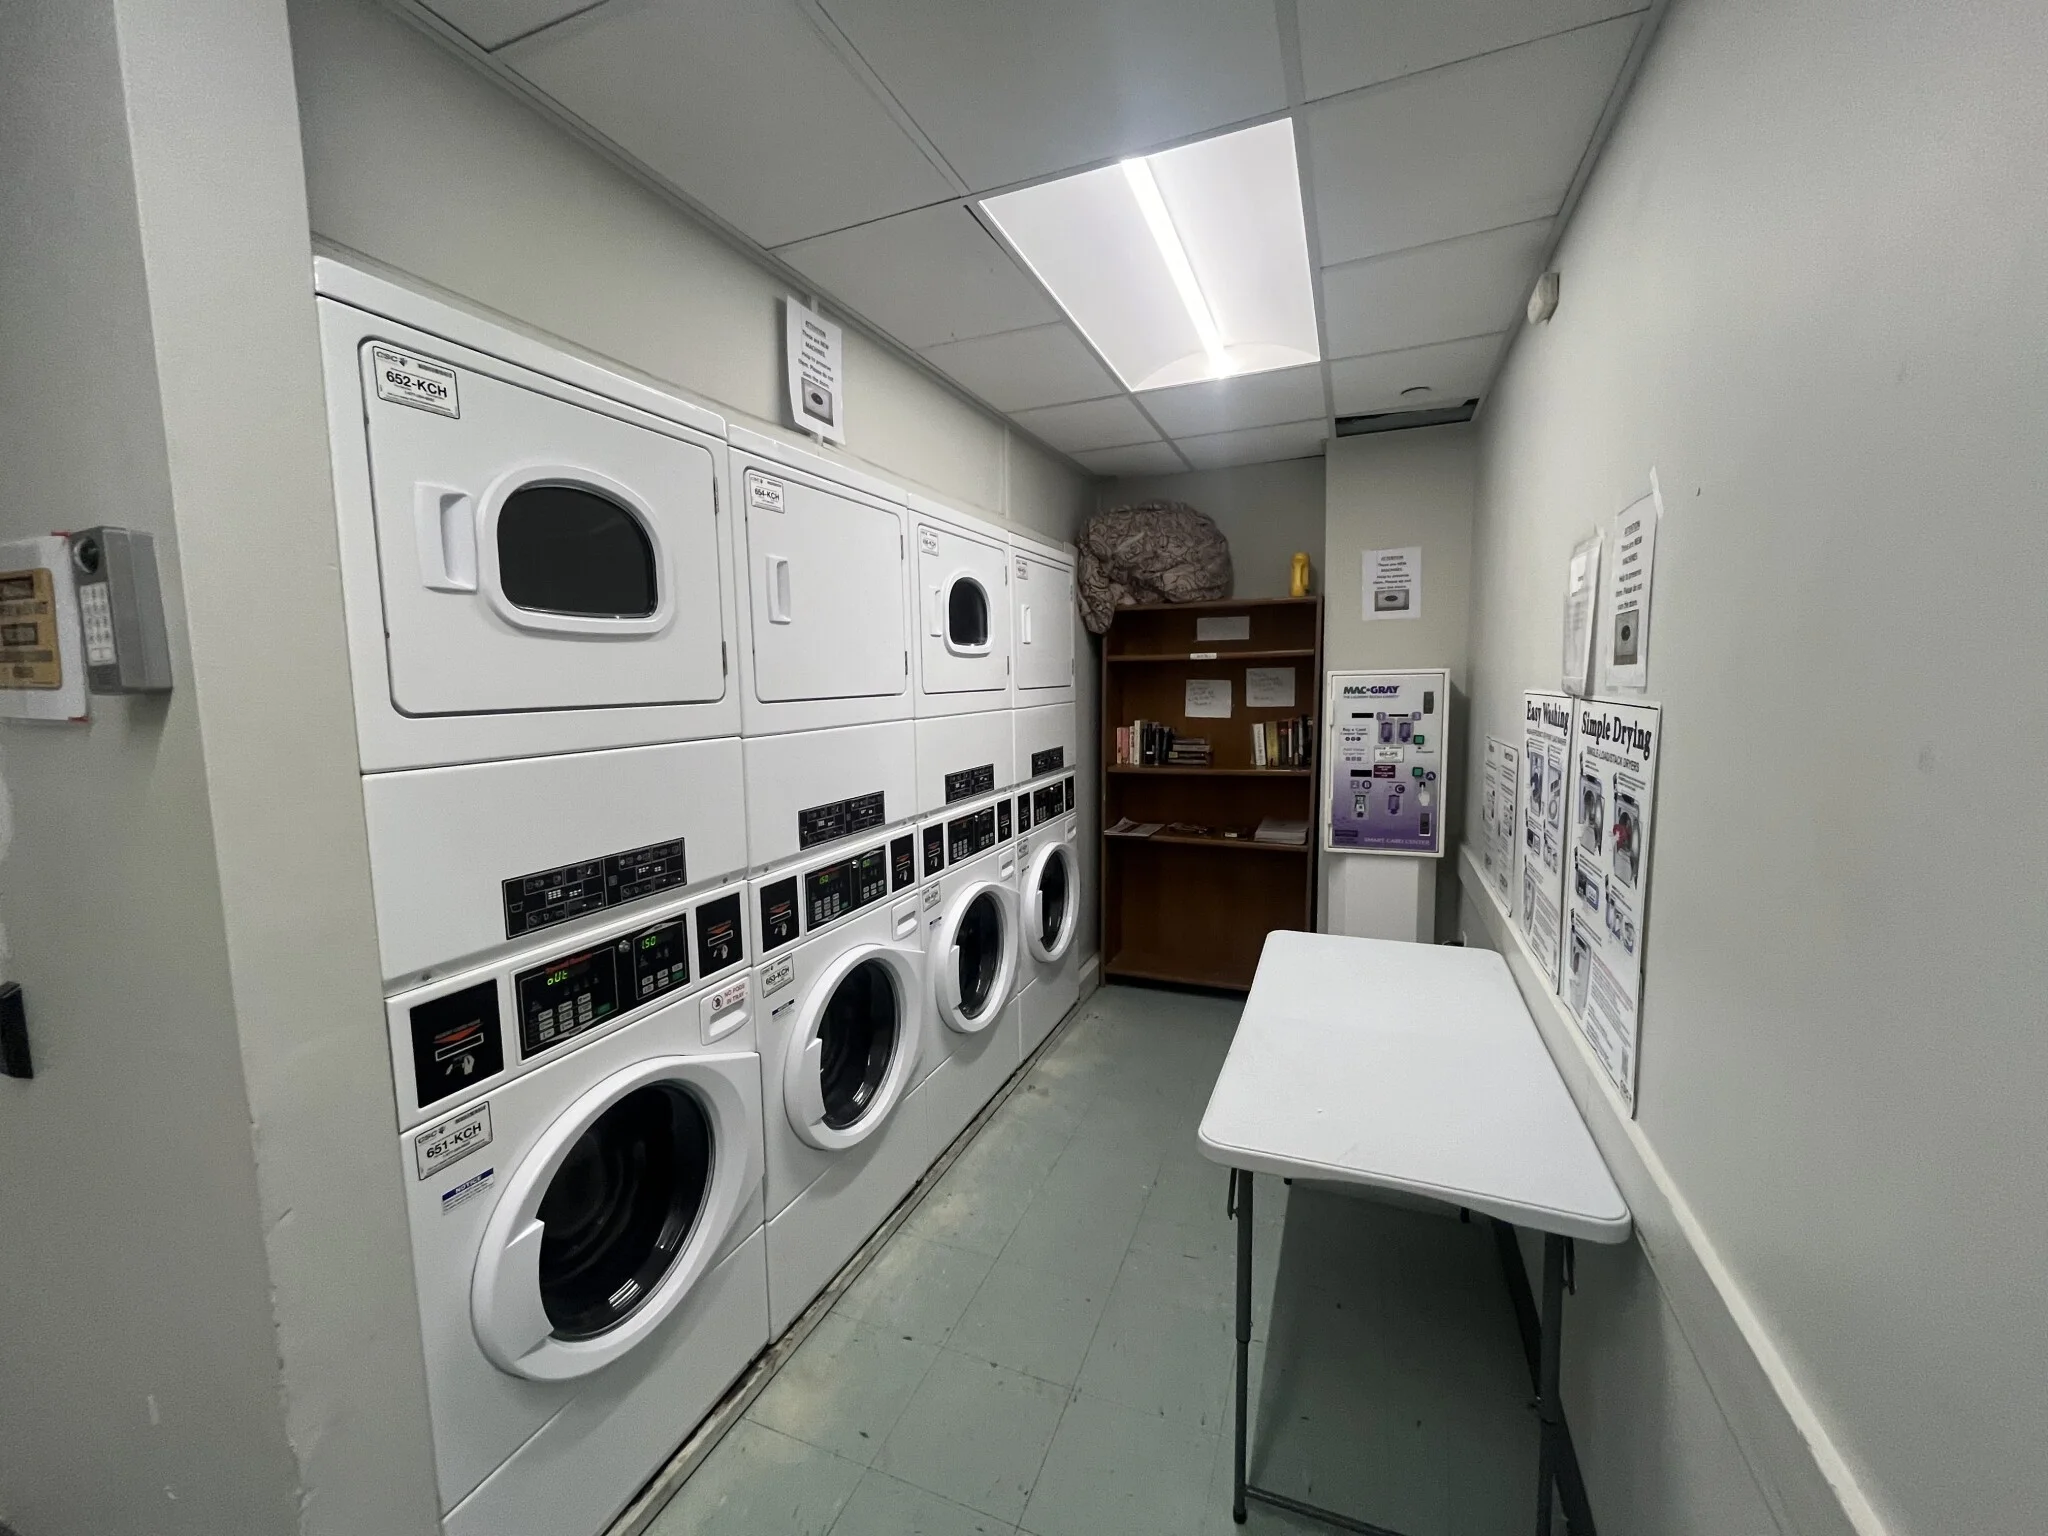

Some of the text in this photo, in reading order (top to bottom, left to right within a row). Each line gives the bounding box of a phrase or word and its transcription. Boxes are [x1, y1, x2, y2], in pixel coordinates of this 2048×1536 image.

[386, 371, 448, 398] 652-KCH
[1527, 701, 1542, 728] Easy
[1543, 702, 1569, 737] Washing
[1582, 711, 1610, 746] Simple
[1612, 716, 1652, 761] Drying
[723, 989, 732, 998] NO
[426, 1122, 483, 1159] 651-KCH
[455, 1175, 483, 1194] NOTICE
